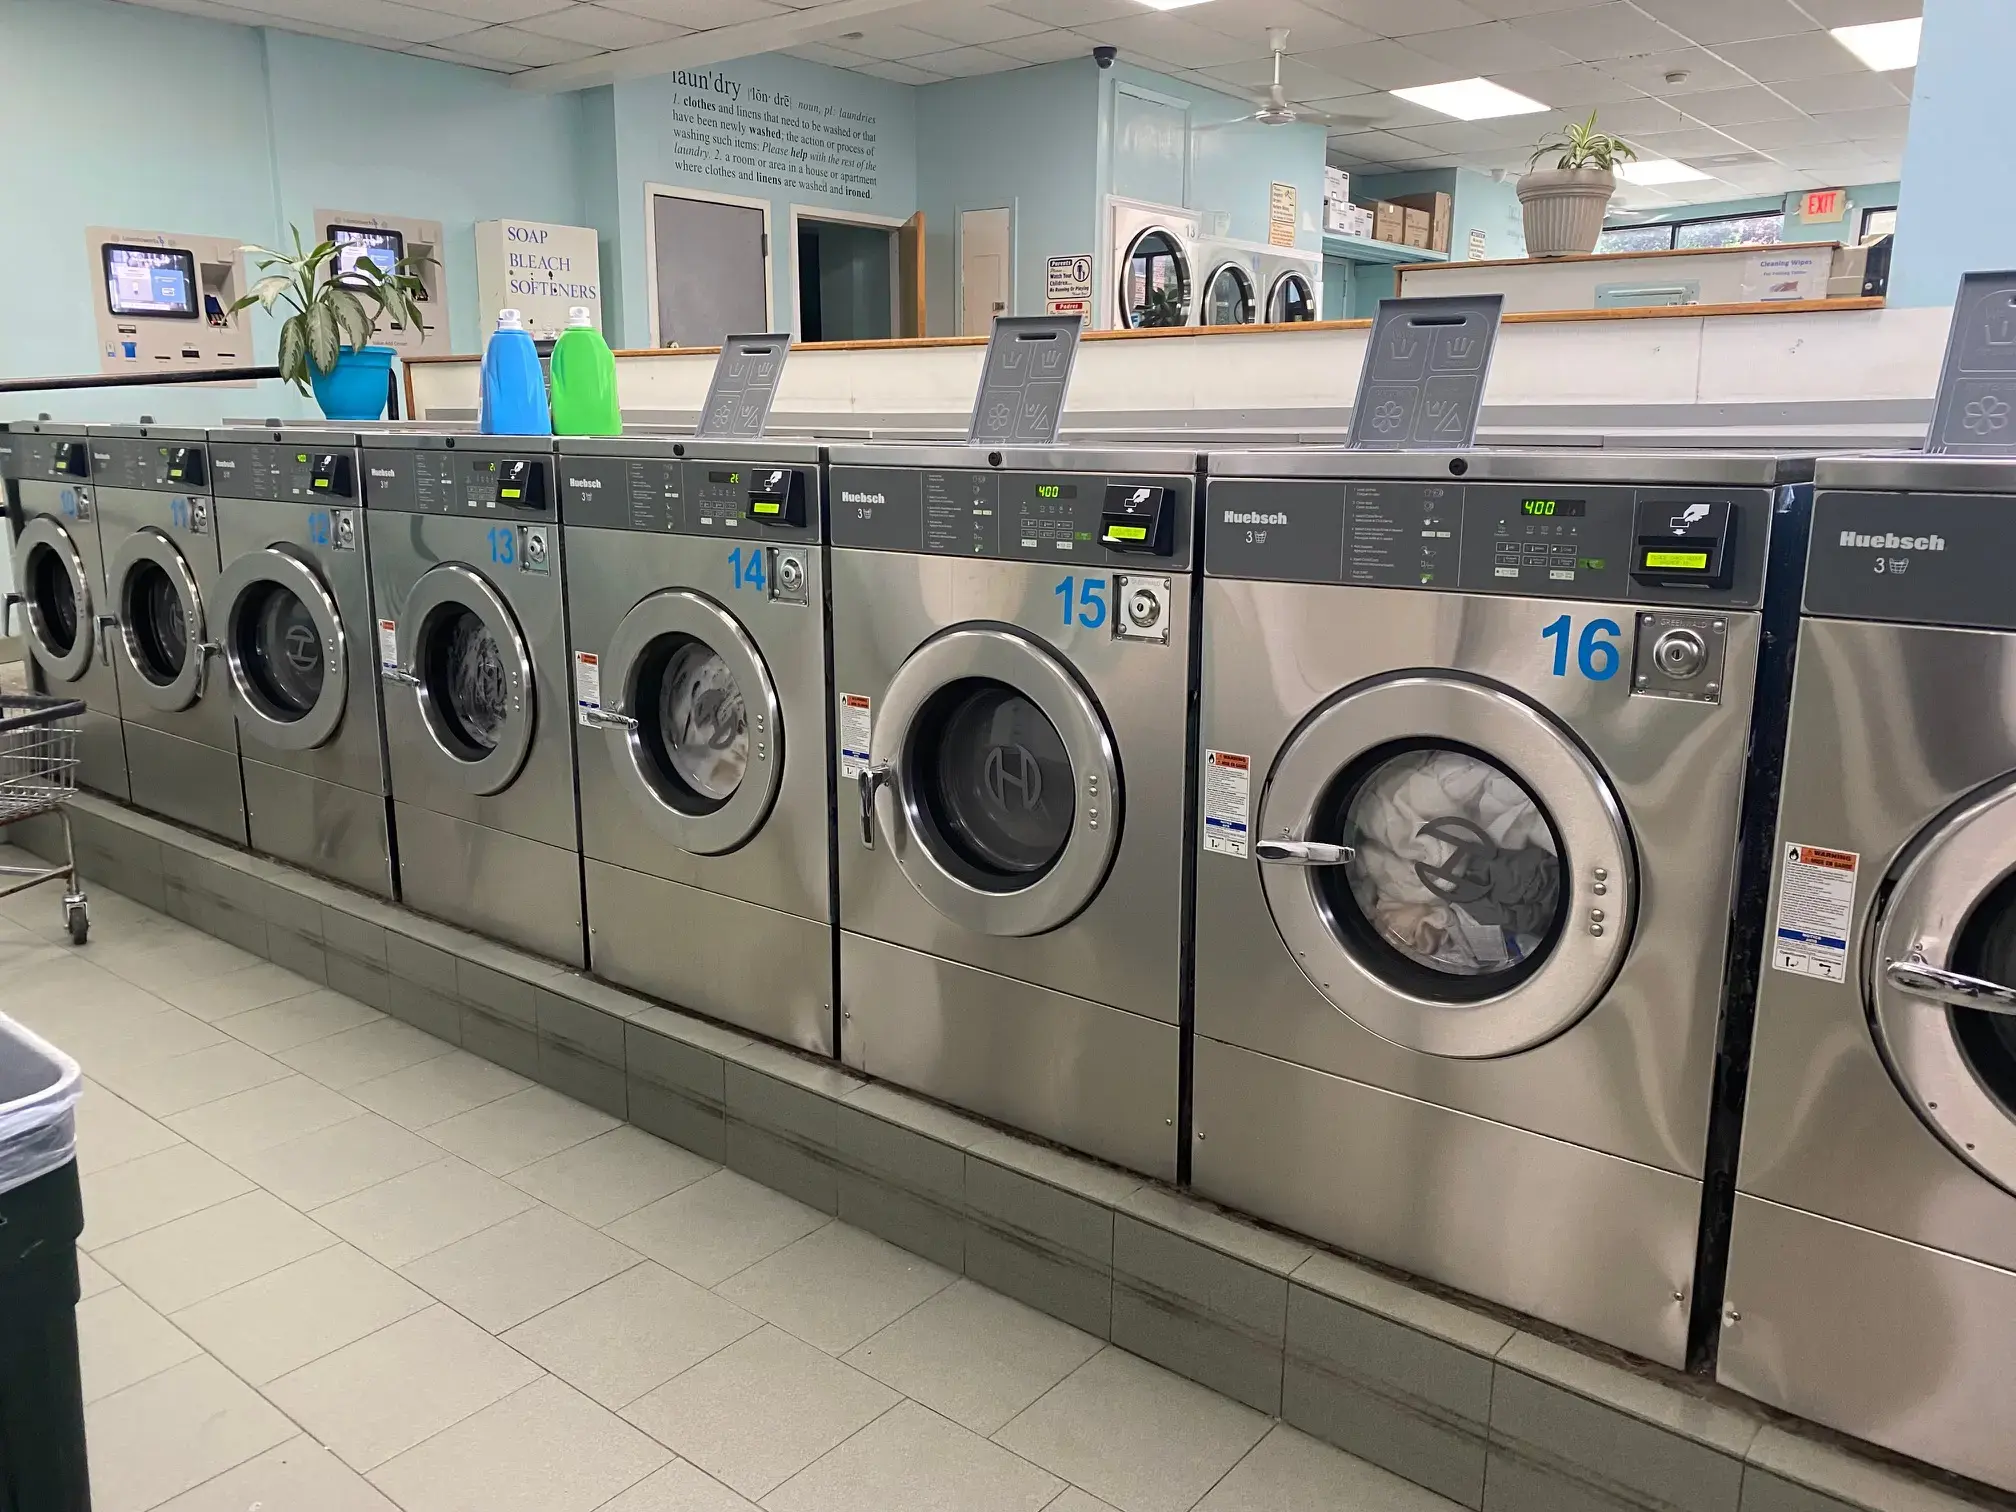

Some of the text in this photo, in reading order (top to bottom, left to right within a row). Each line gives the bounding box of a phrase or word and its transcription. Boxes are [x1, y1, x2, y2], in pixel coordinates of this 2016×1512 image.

[684, 96, 716, 111] clothes
[719, 104, 734, 115] and
[737, 105, 761, 120] linens
[764, 111, 779, 124] that
[782, 117, 799, 127] need
[802, 120, 809, 129] to
[812, 120, 820, 132] be
[823, 124, 851, 138] washed
[853, 130, 860, 139] or
[863, 131, 876, 142] that
[839, 108, 876, 124] laundries
[673, 109, 875, 156] have been newly washed; the action or process of
[673, 128, 876, 172] washing such items: Please help with the rest of the
[674, 143, 877, 186] laundry. 2. a room or area in a house or apartment
[675, 160, 873, 199] where clothes and linens are washed and ironed.
[1808, 192, 1836, 214] EXIT
[507, 227, 548, 244] SOAP
[1186, 225, 1196, 238] 13
[510, 253, 570, 271] BLEACH
[511, 280, 596, 300] SOFTENERS
[371, 468, 395, 478] Huebsch
[570, 478, 602, 489] Huebsch
[1039, 486, 1059, 498] 400
[582, 492, 586, 501] 3
[842, 492, 885, 504] Huebsch
[171, 496, 187, 528] 11
[857, 508, 862, 519] 3
[1525, 500, 1556, 515] 400
[1224, 511, 1287, 524] Huebsch
[308, 512, 329, 544] 12
[1245, 530, 1253, 543] 3
[487, 526, 514, 565] 13
[1840, 530, 1945, 551] Huebsch
[728, 547, 766, 591] 14
[1874, 557, 1885, 573] 3
[1055, 576, 1106, 628] 15
[1542, 614, 1622, 681] 16
[1814, 850, 1851, 861] WARNING
